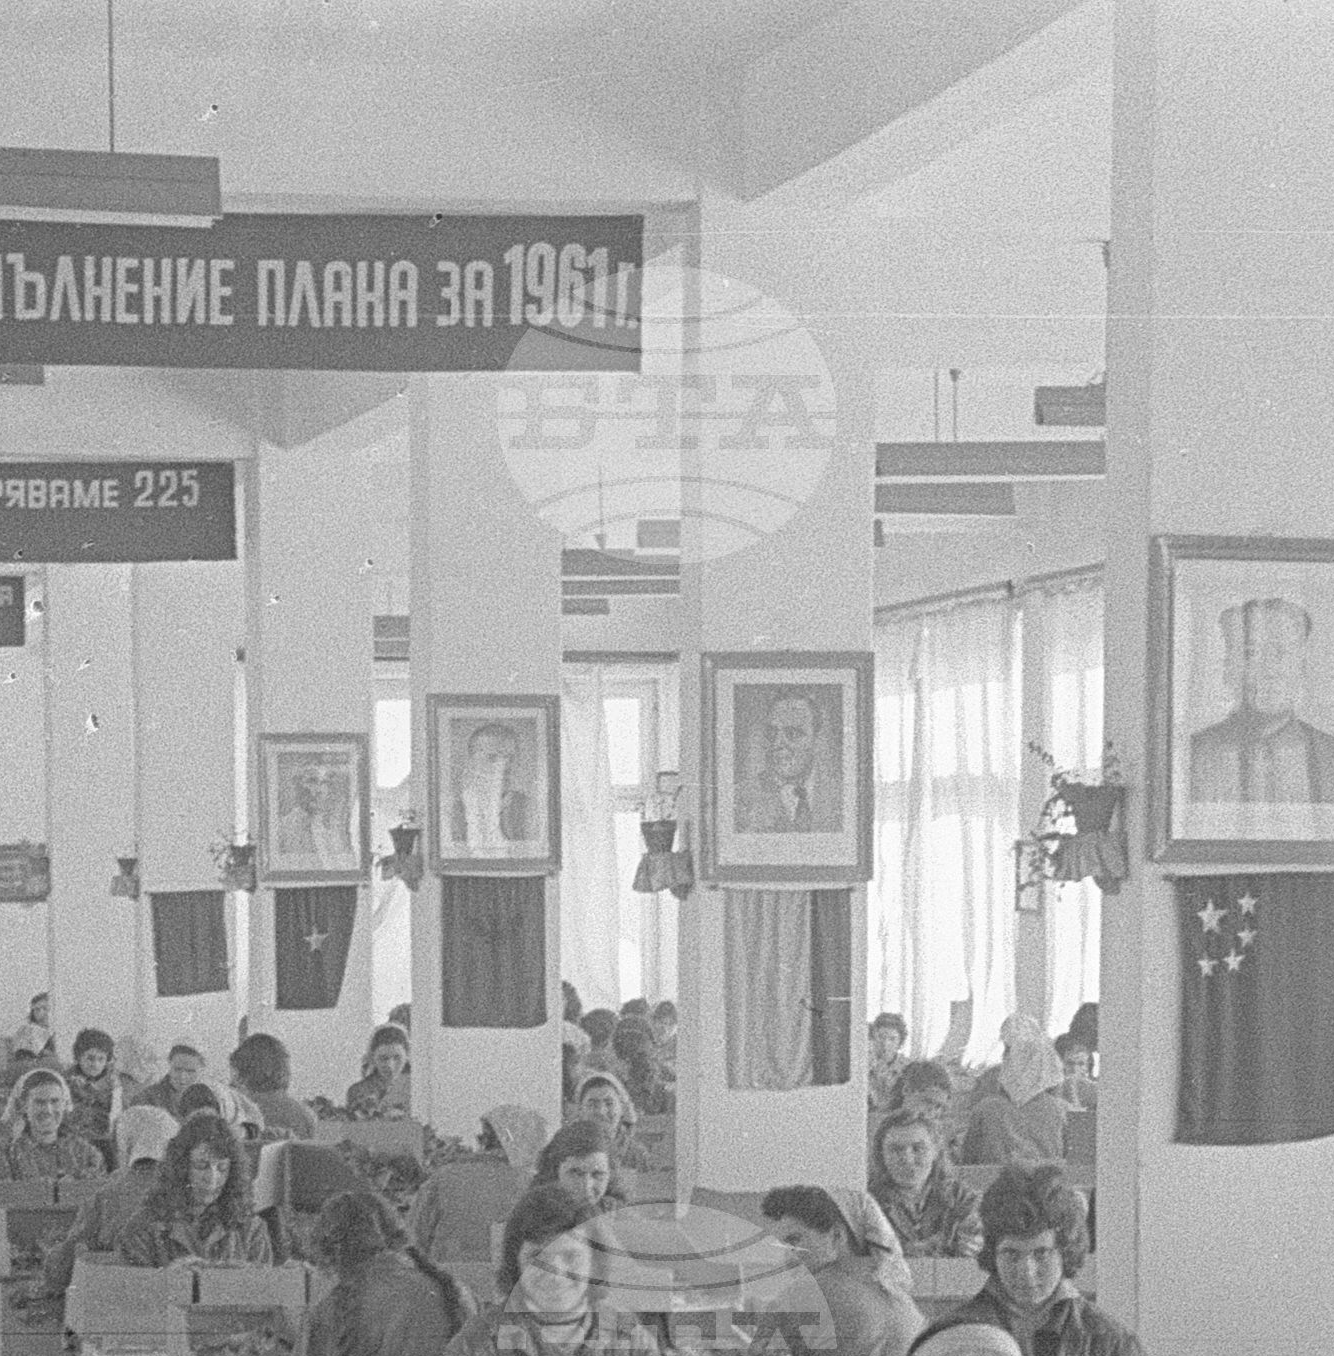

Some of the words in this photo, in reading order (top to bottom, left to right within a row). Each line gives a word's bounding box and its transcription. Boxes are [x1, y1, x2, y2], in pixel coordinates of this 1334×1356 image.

[256, 259, 419, 329] ПЛАНА
[436, 260, 494, 329] ЗА
[132, 469, 200, 509] 225
